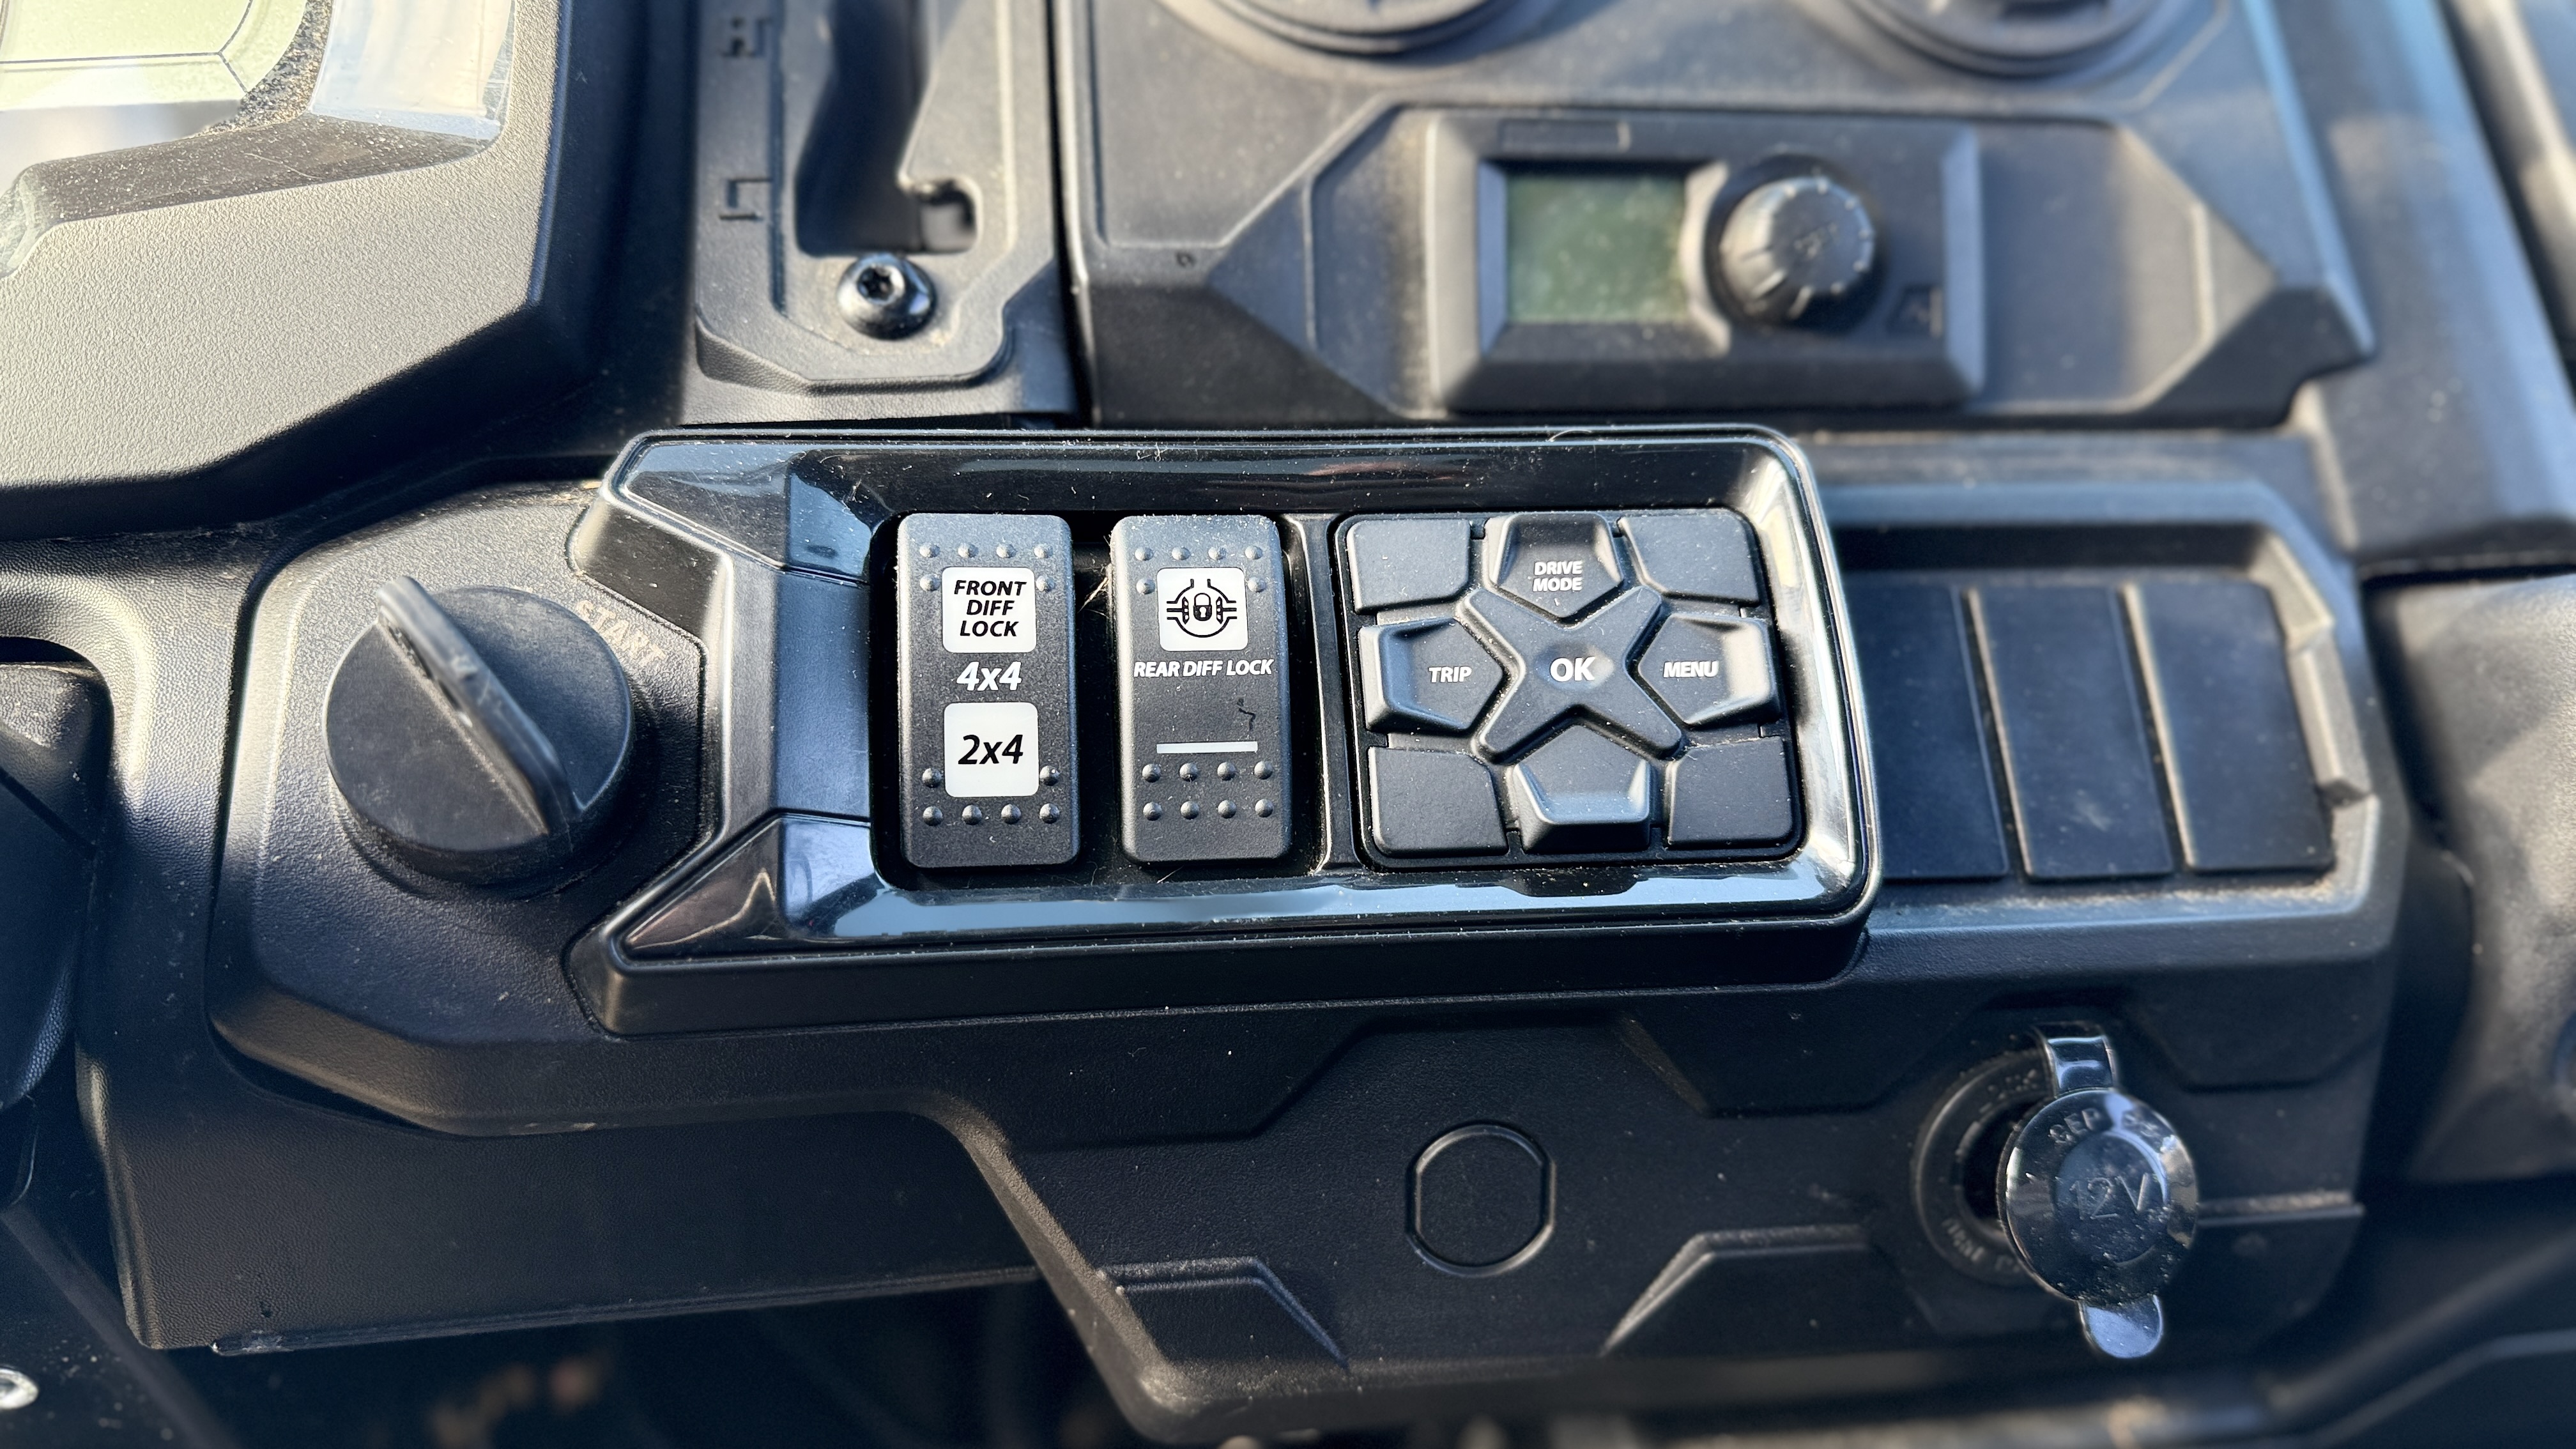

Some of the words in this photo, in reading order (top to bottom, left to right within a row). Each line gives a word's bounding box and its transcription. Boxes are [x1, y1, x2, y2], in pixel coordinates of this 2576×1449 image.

[1533, 561, 1583, 576] DRIVE
[954, 579, 1027, 596] FRONT
[1533, 576, 1583, 592] MODE
[967, 599, 1015, 616] DIFF
[960, 620, 1018, 637] LOCK
[956, 661, 1022, 691] 4x4
[1133, 660, 1180, 677] REAR
[1183, 660, 1224, 677] DIFF
[1226, 659, 1275, 675] LOCK
[1429, 666, 1472, 683] TRIP
[1550, 656, 1596, 682] OK
[1663, 661, 1719, 678] MENU
[958, 734, 1023, 765] 2x4
[2069, 1172, 2151, 1220] 12V
